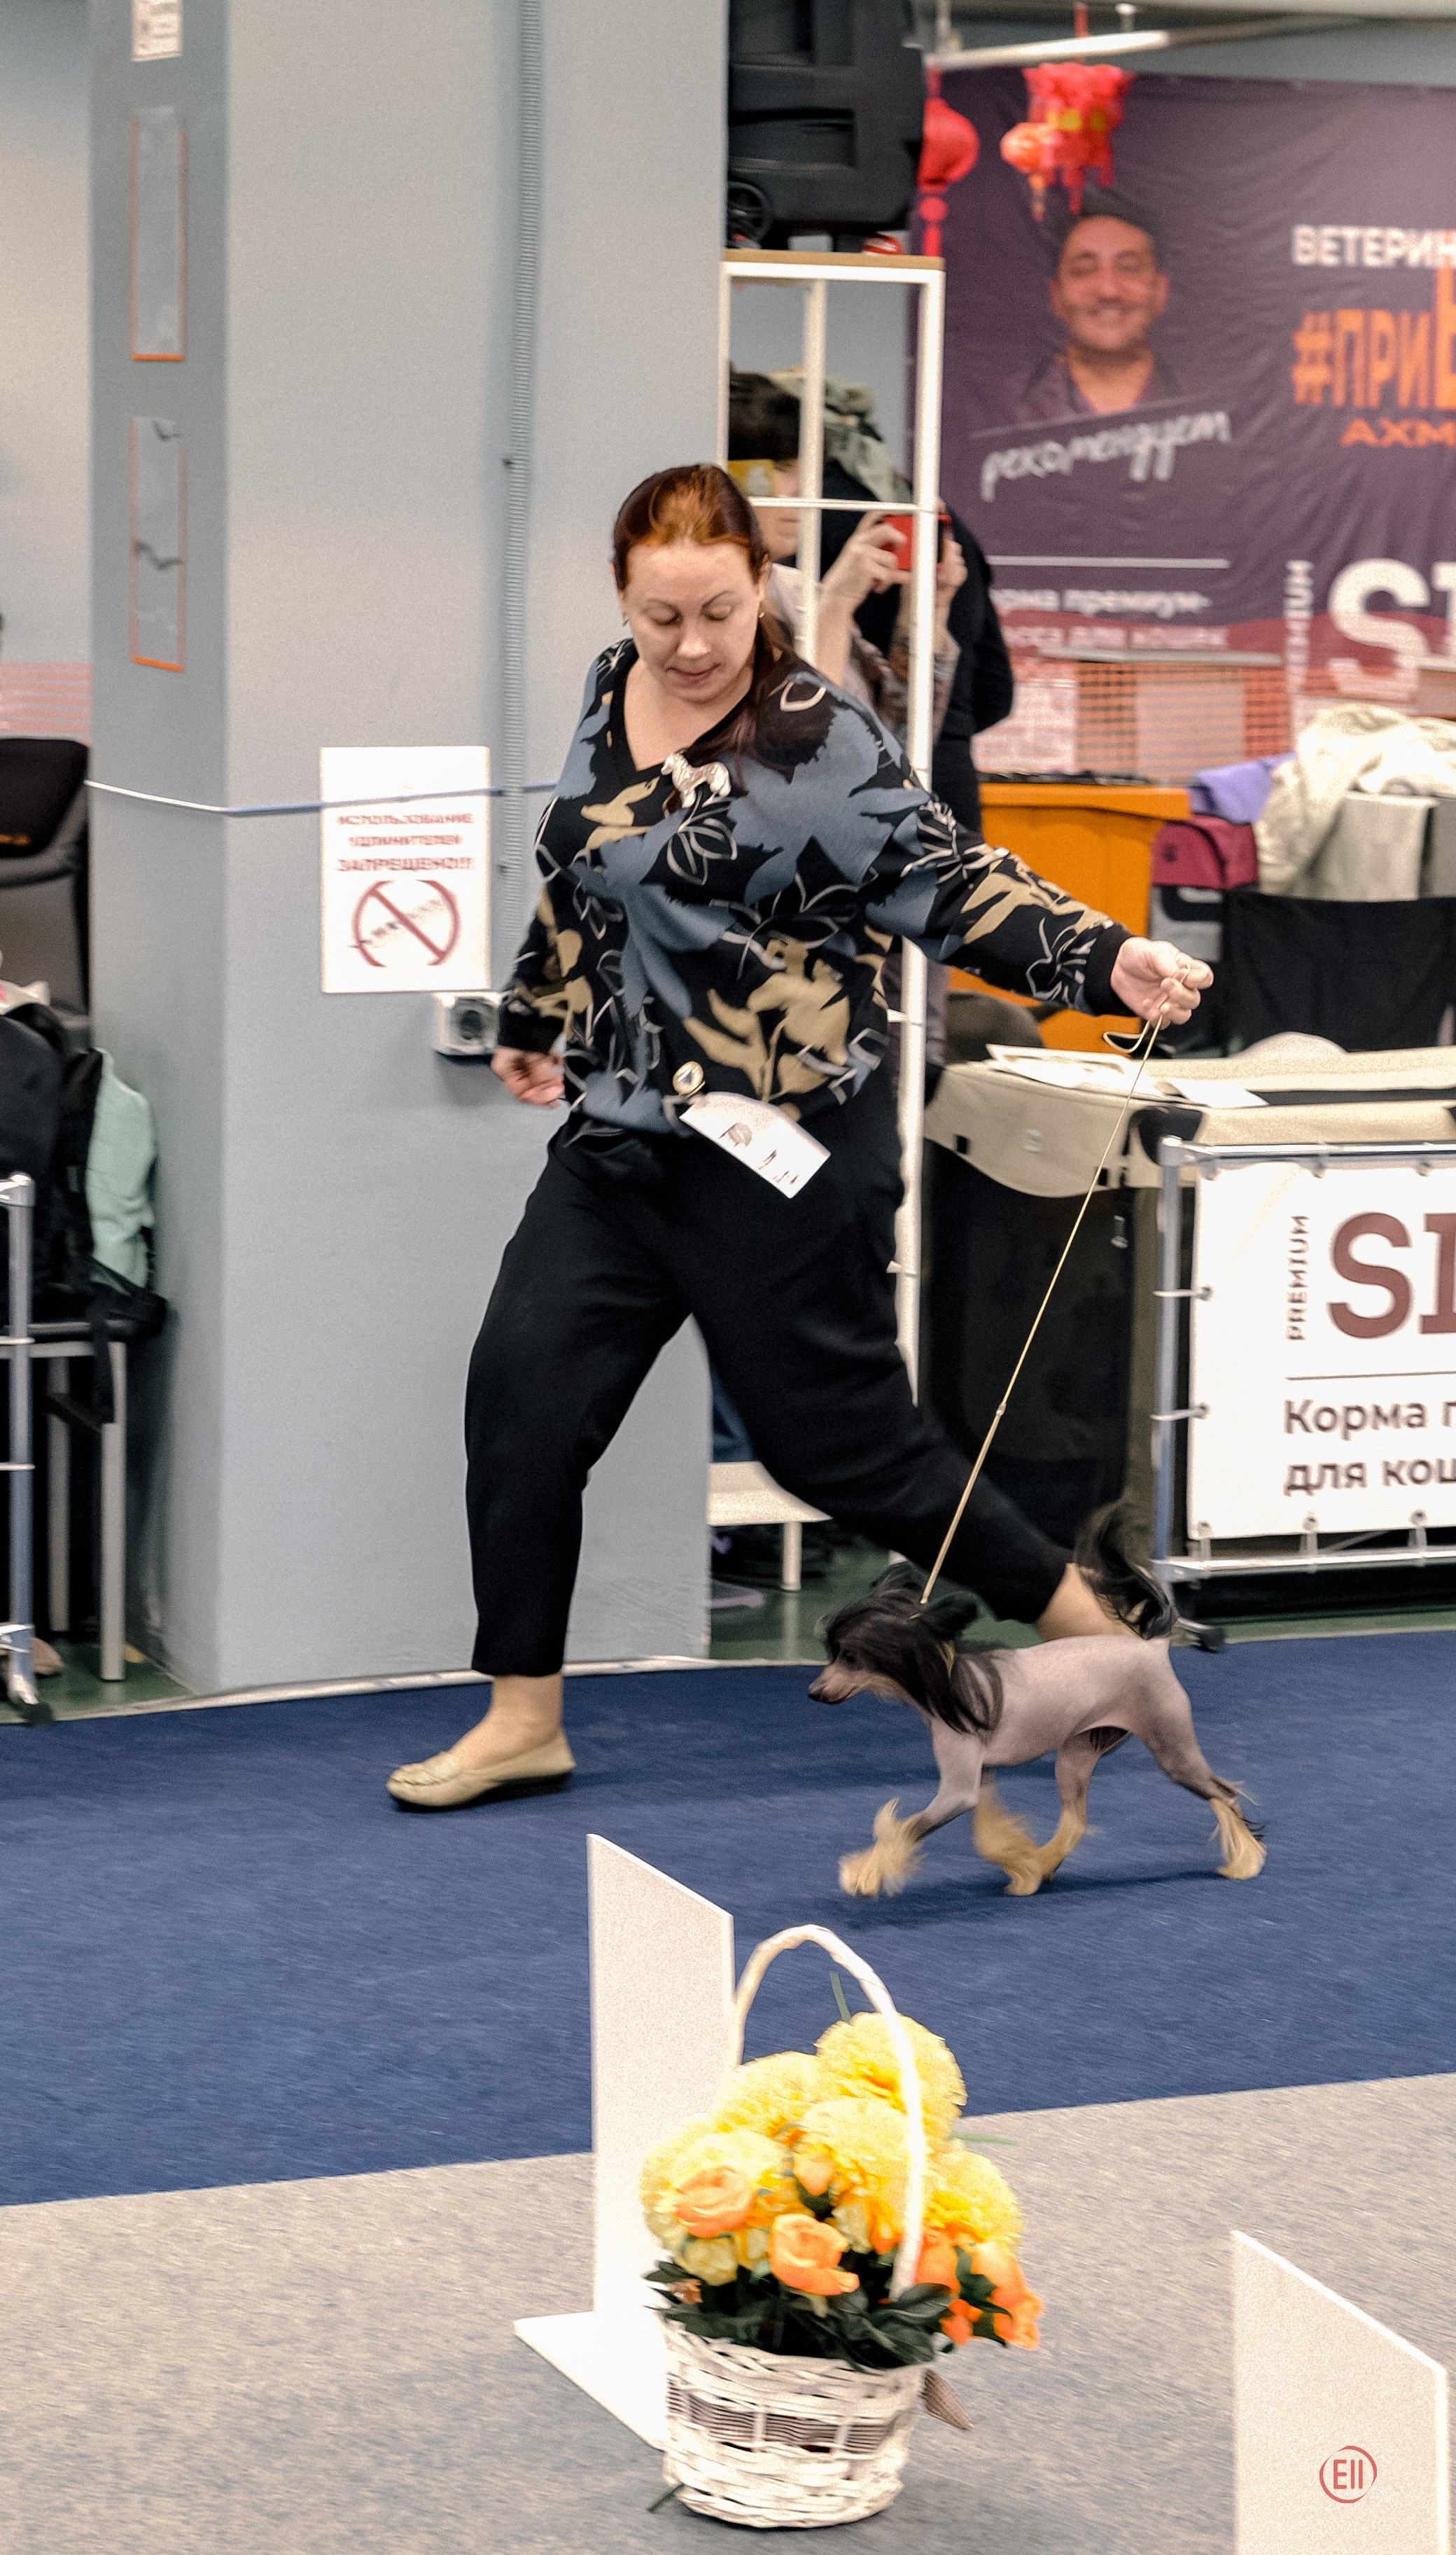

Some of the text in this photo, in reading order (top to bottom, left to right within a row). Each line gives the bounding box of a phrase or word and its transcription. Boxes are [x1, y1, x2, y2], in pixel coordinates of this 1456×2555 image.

[1287, 1215, 1310, 1342] PREMIUM
[1284, 1400, 1427, 1440] Корма
[1283, 1461, 1367, 1496] для
